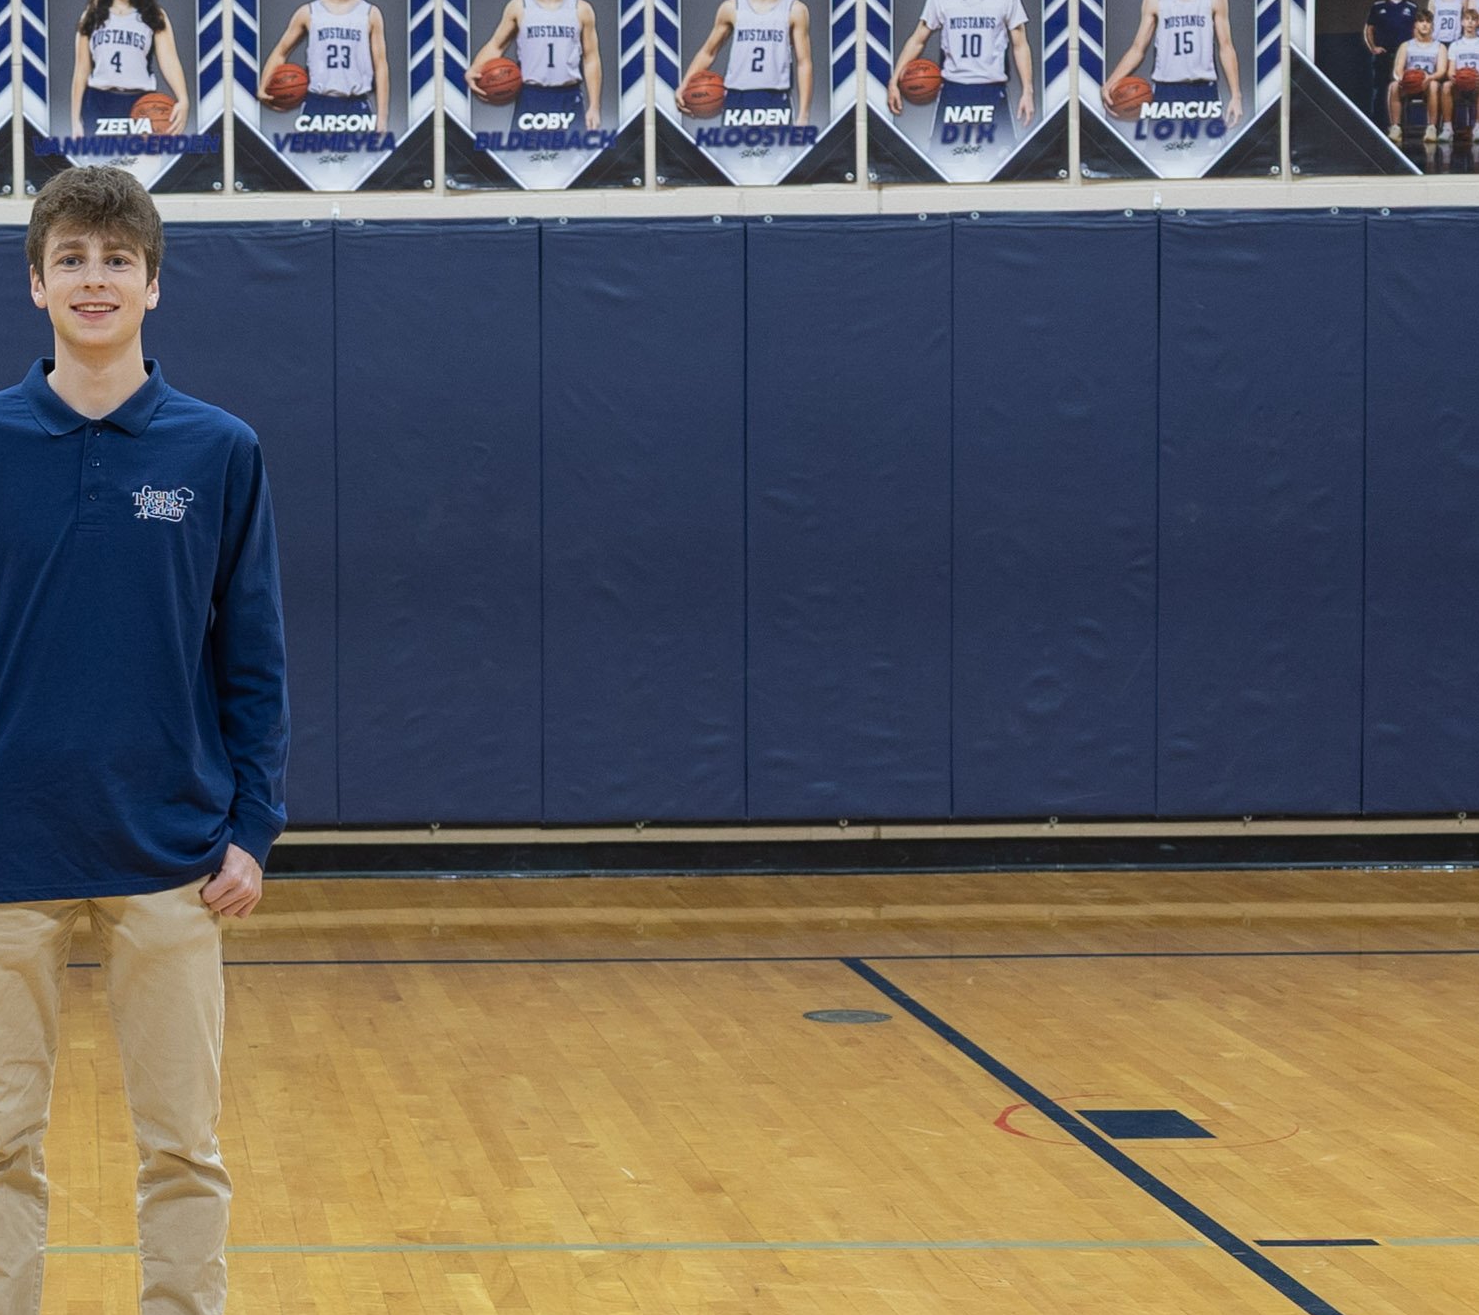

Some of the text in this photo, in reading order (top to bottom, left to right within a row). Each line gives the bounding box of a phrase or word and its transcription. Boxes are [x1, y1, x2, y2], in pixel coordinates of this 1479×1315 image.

[950, 17, 996, 30] MUSTANGS
[1164, 15, 1205, 29] MUSTANGS
[318, 27, 361, 42] MUSTANGS
[527, 26, 575, 39] MUSTANGS
[737, 29, 783, 43] MUSTANGS
[961, 34, 982, 58] 10
[1174, 31, 1194, 56] 15
[110, 51, 122, 73] 4
[327, 45, 350, 69] 23
[547, 44, 555, 68] 1
[751, 47, 765, 72] 2
[724, 108, 790, 126] KADEN
[944, 106, 994, 123] NATE
[1140, 101, 1223, 119] MARCUS
[95, 118, 153, 135] ZEEVA
[295, 114, 377, 132] CARSON
[518, 113, 575, 130] COBY
[1134, 120, 1227, 141] LONG
[274, 131, 397, 153] VERMILYEA
[474, 129, 617, 151] BILDERBACK
[695, 126, 818, 147] KLOOSTER
[941, 123, 995, 145] DIX
[33, 134, 220, 156] VANWINGERDEN
[142, 485, 175, 500] Grand
[134, 506, 185, 522] Academy
